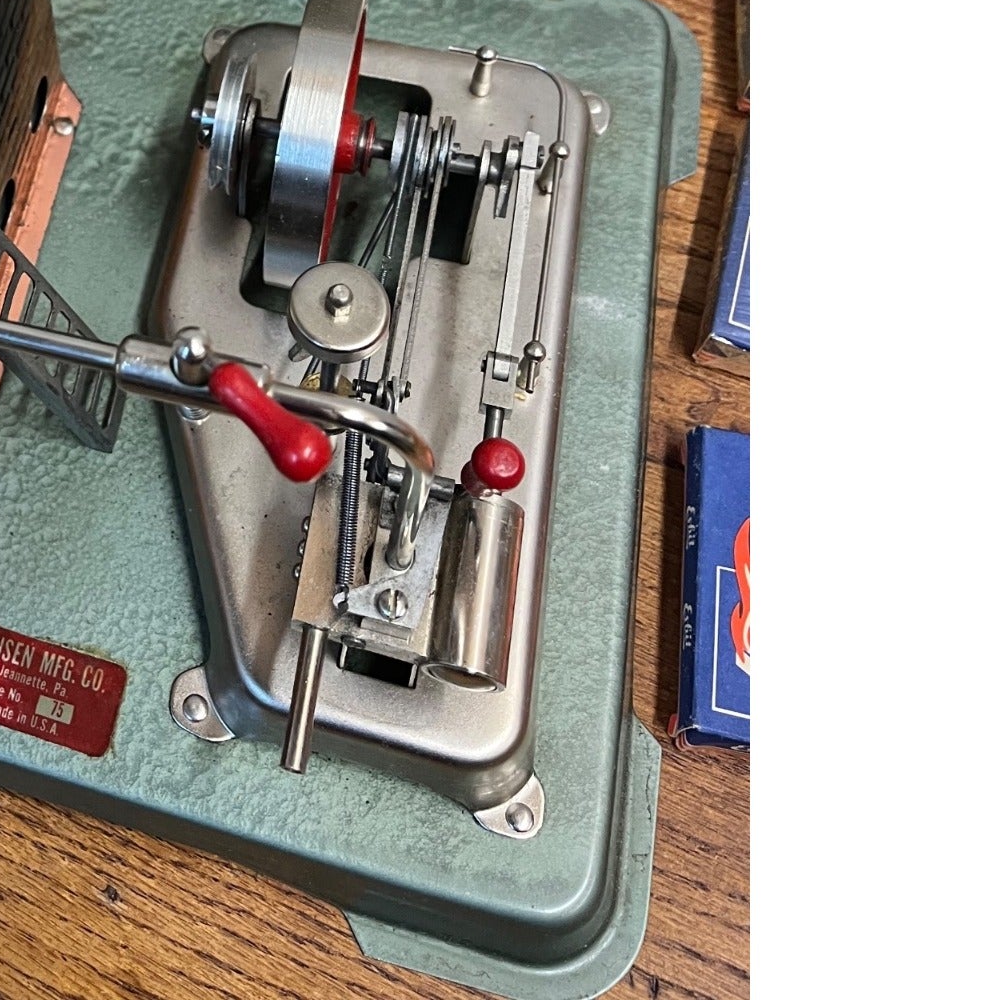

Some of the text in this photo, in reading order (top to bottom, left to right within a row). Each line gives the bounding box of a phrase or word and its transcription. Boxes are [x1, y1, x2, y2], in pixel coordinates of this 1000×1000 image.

[39, 651, 75, 684] MFG.
[80, 665, 105, 693] CO.
[8, 687, 23, 704] No.
[50, 700, 65, 718] 75
[16, 710, 27, 725] in
[30, 714, 59, 736] U.S.A.
